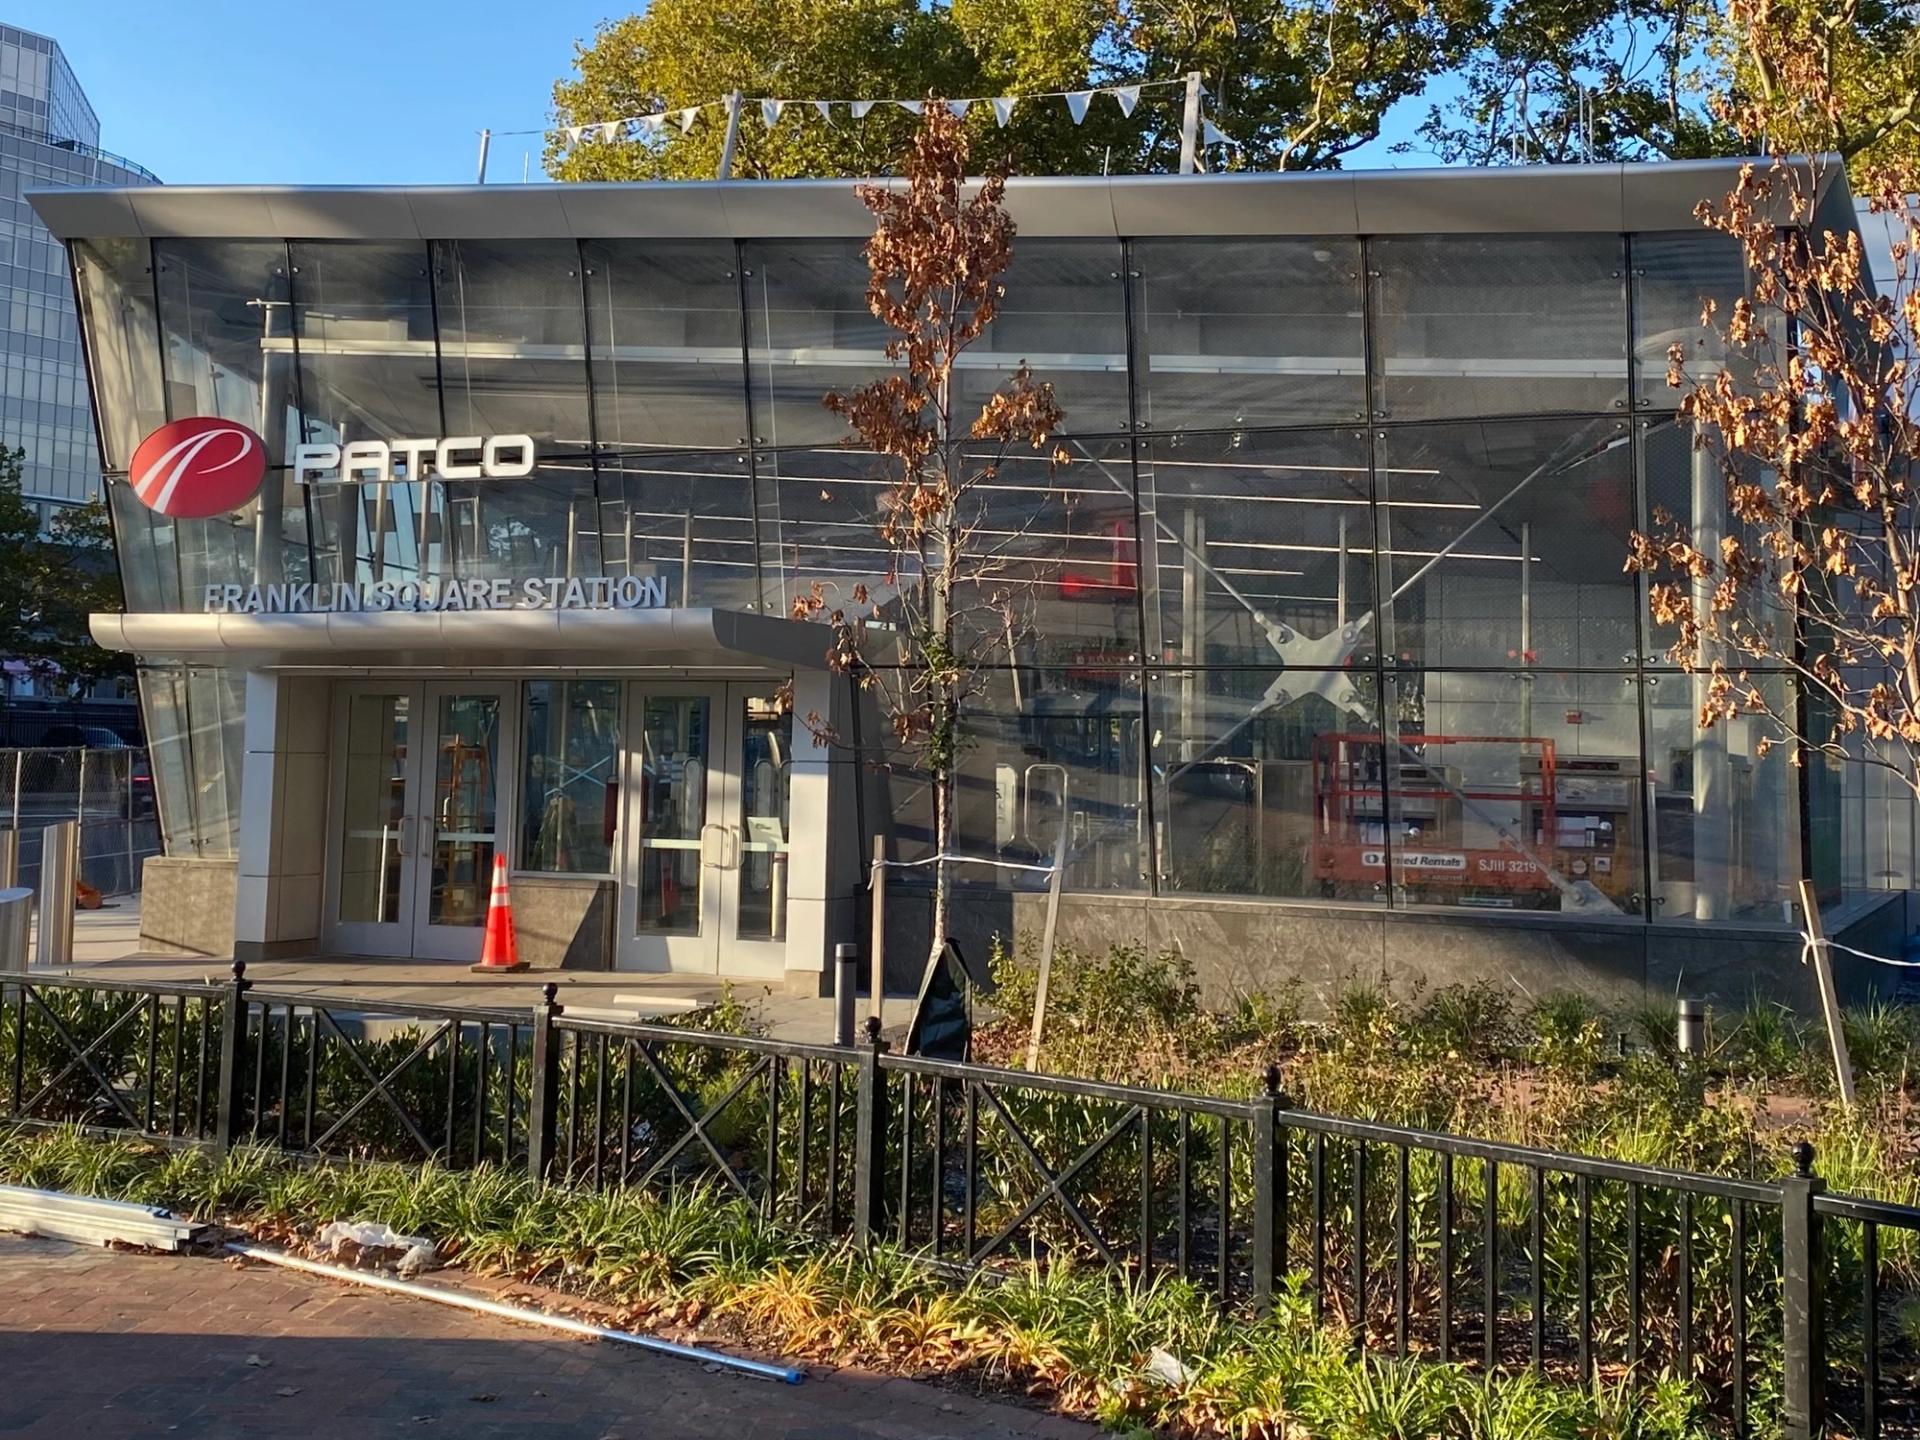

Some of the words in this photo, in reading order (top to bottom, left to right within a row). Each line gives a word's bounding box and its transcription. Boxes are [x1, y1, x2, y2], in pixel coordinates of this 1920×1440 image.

[294, 434, 534, 483] PATCO
[204, 583, 365, 613] FRANKLIN
[370, 580, 512, 611] SQUARE
[523, 575, 667, 610] STATION
[1420, 856, 1461, 867] Rentals
[1508, 860, 1537, 873] 3219
